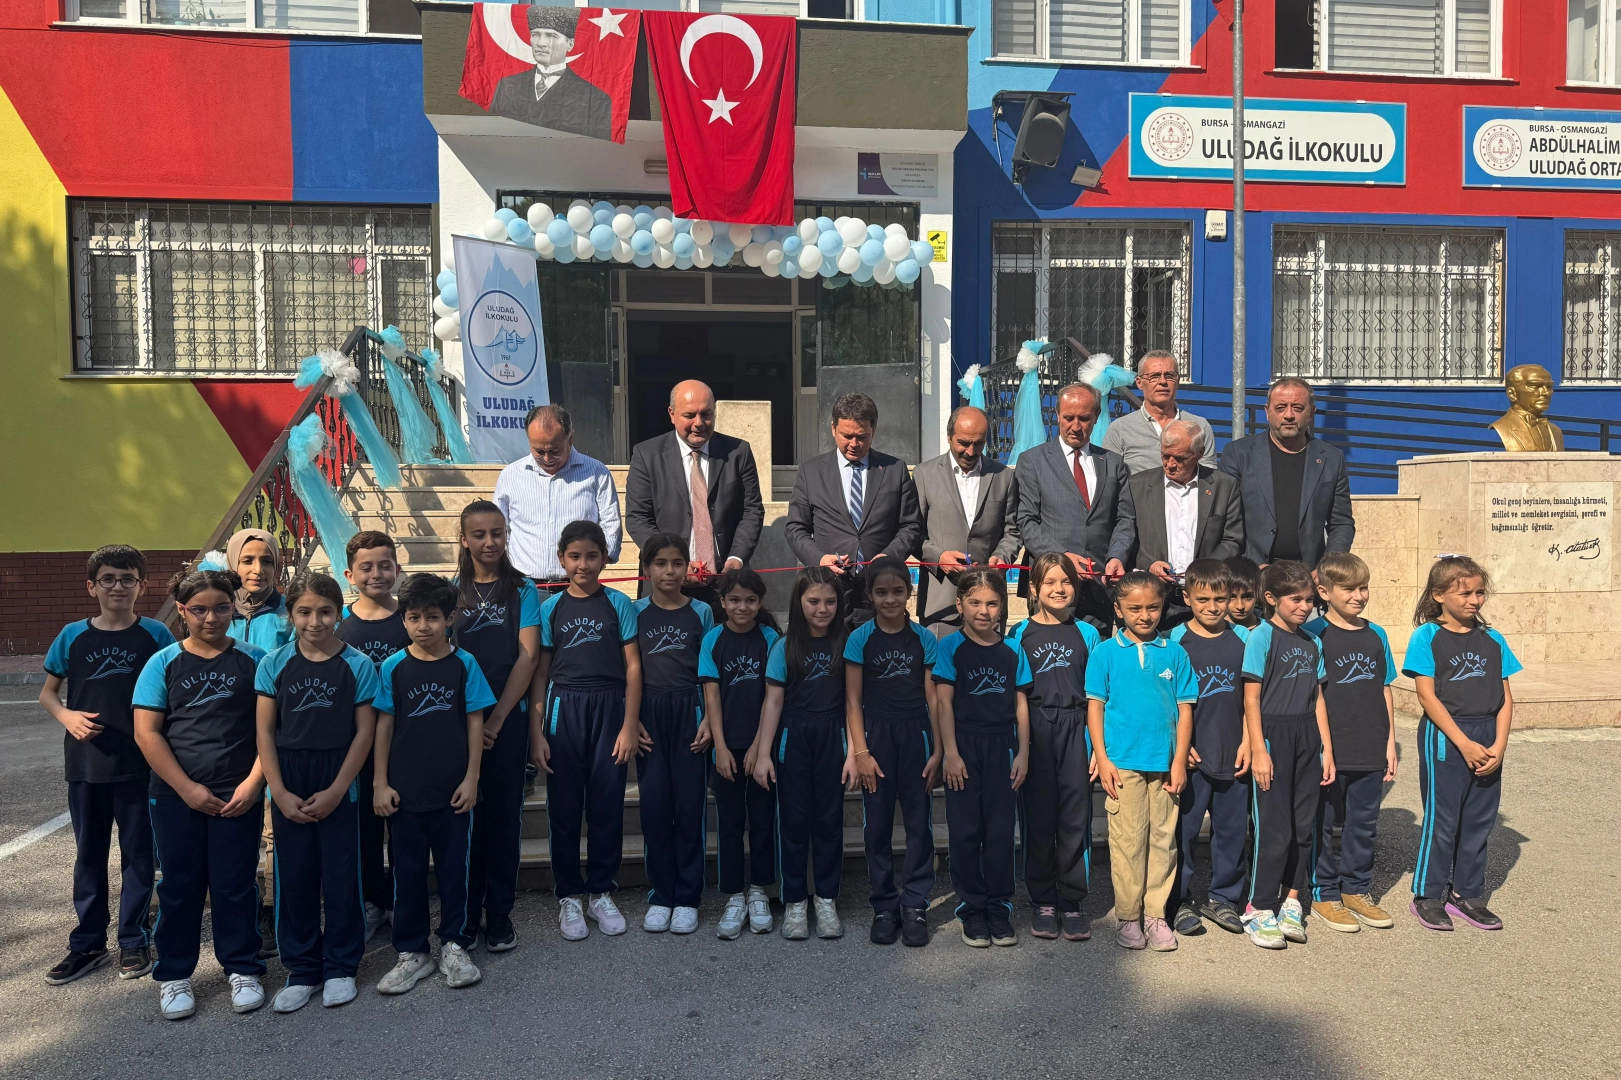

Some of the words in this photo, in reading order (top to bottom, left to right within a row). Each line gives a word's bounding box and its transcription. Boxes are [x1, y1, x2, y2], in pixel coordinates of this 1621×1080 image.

[1201, 118, 1229, 127] BURSA
[1242, 119, 1286, 129] SMANGAZİ
[1529, 124, 1555, 133] BURSA
[1560, 125, 1608, 134] OSMANGAZİ
[1289, 137, 1383, 163] İLKOKULU
[1529, 135, 1620, 154] ABDÜLHALİM
[1529, 158, 1586, 176] ULUDAĞ
[485, 311, 519, 322] İLKOKULU
[487, 304, 515, 314] ULUDAĞ
[482, 396, 536, 411] ULUDAĞ
[1492, 497, 1507, 505] Okul
[1508, 498, 1522, 507] genç
[1522, 497, 1552, 507] beyinlere,
[1553, 497, 1581, 506] insanlığa
[1582, 496, 1608, 505] hürmeti,
[1491, 510, 1510, 518] millet
[1520, 510, 1549, 518] memleket
[1550, 510, 1579, 519] sevgisini,
[1581, 509, 1599, 519] şerefi
[1491, 523, 1529, 533] bağımsızlığı
[1531, 522, 1554, 532] öğretir.
[560, 617, 604, 634] ULUDAĞ
[646, 625, 689, 640] ULUDAĞ
[85, 646, 138, 663] ULUDAĞ
[357, 640, 397, 655] LUDAĞ
[1032, 641, 1074, 659] ULUDAĞ
[1280, 647, 1314, 664] ULUDAĞ
[872, 650, 914, 666] ULUDAĞ
[1334, 652, 1377, 669] ULUDAĞ
[181, 671, 238, 690] ULUDAĞ
[967, 666, 1007, 684] ULUDAĞ
[288, 677, 338, 696] ULUDAĞ
[407, 682, 455, 700] ULUDAĞ
